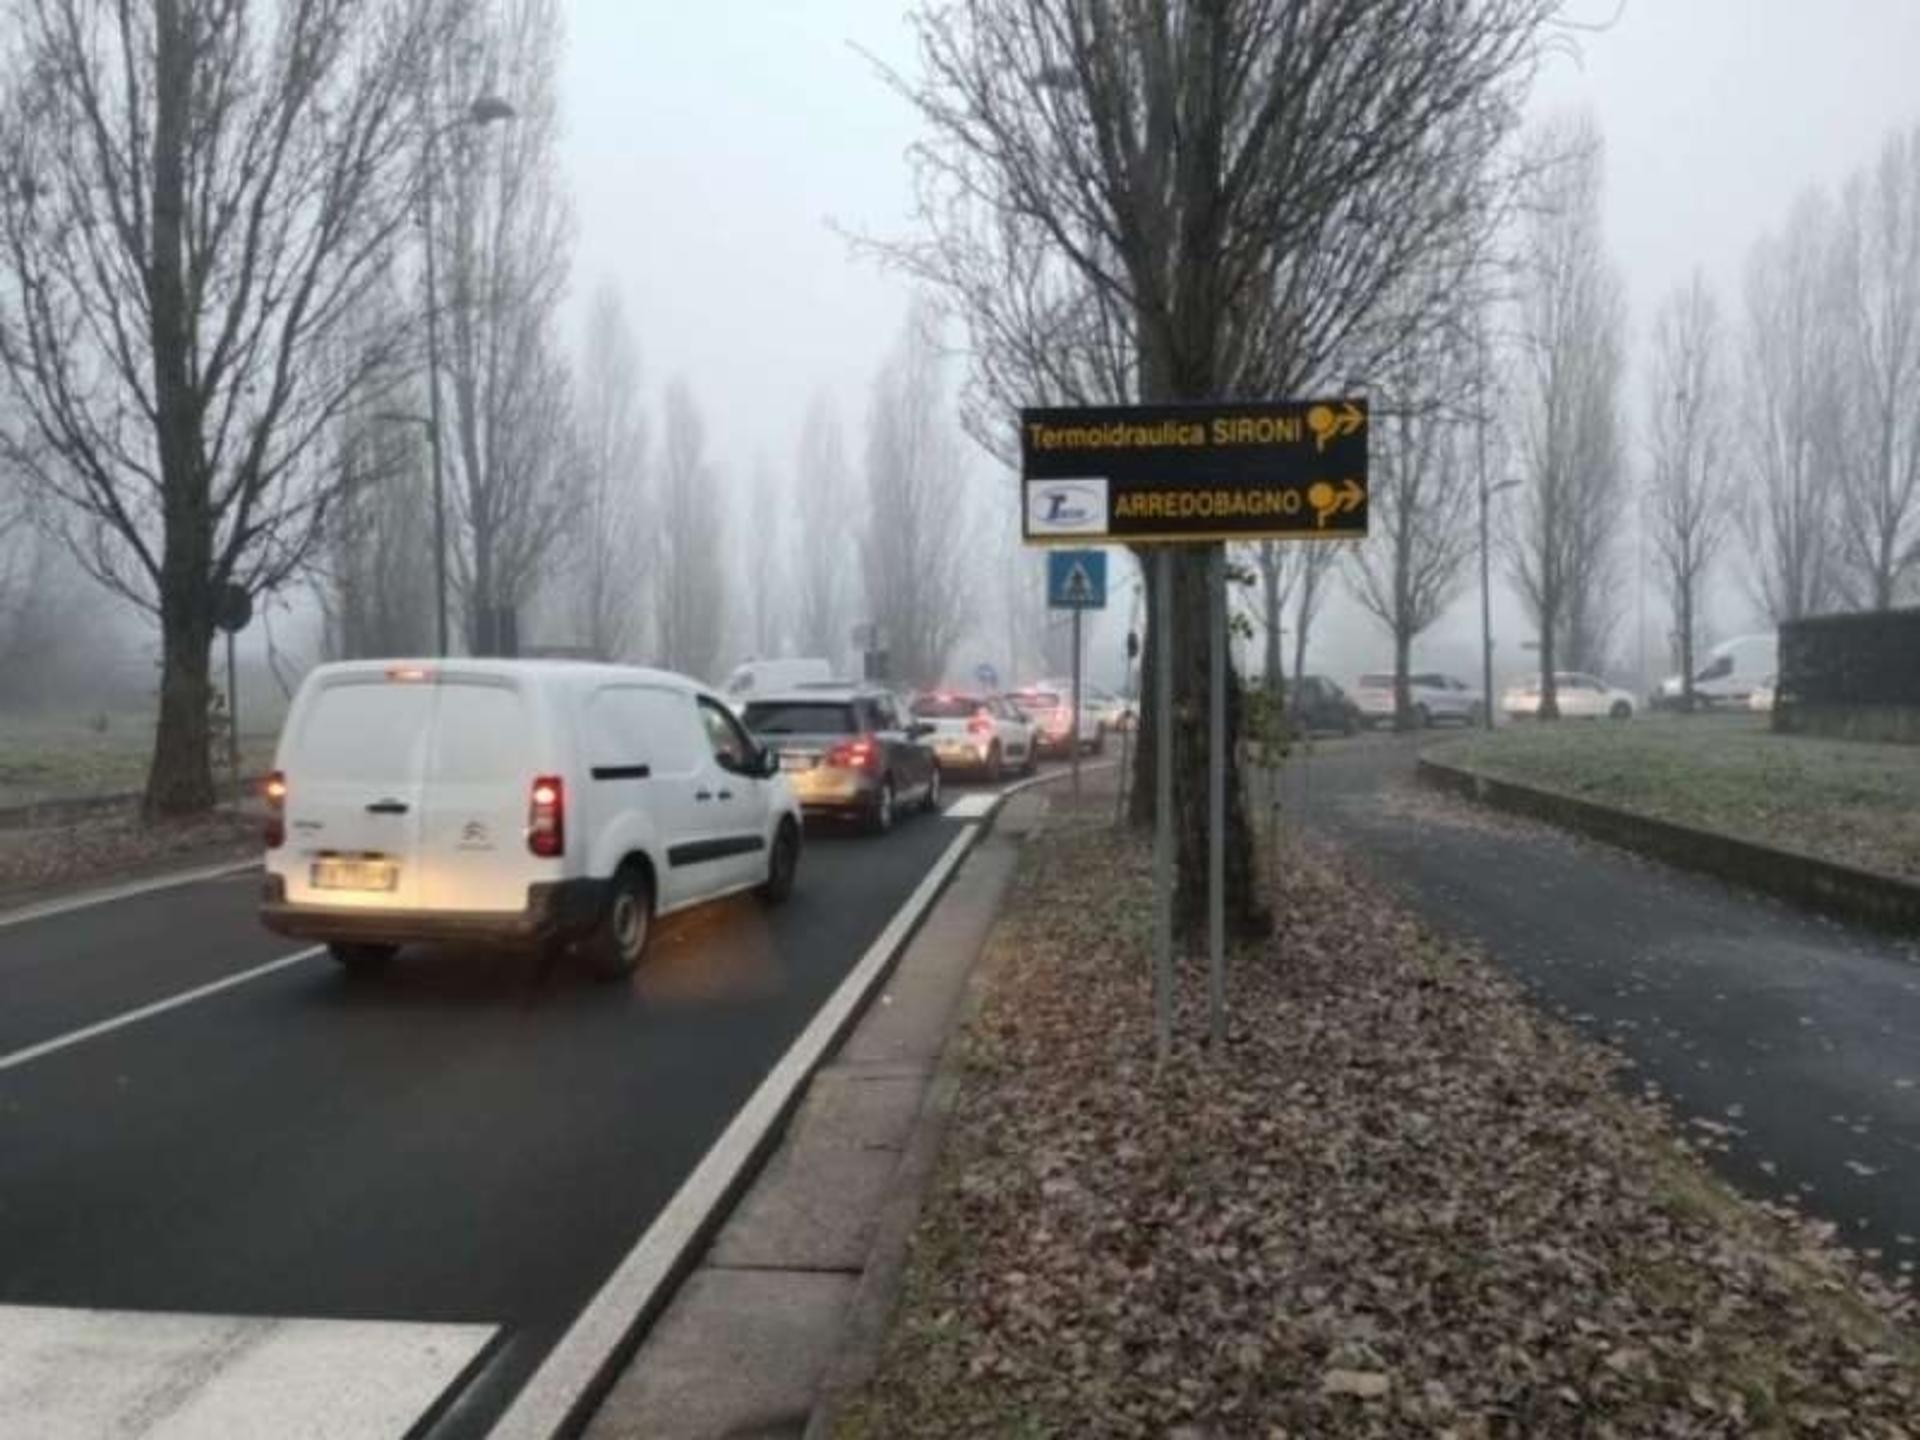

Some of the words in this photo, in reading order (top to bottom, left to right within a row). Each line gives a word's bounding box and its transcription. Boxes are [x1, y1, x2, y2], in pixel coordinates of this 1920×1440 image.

[1030, 422, 1205, 448] Termoidraulica
[1213, 417, 1301, 444] SIRONI
[1115, 490, 1300, 518] ARREDOBAGNO
